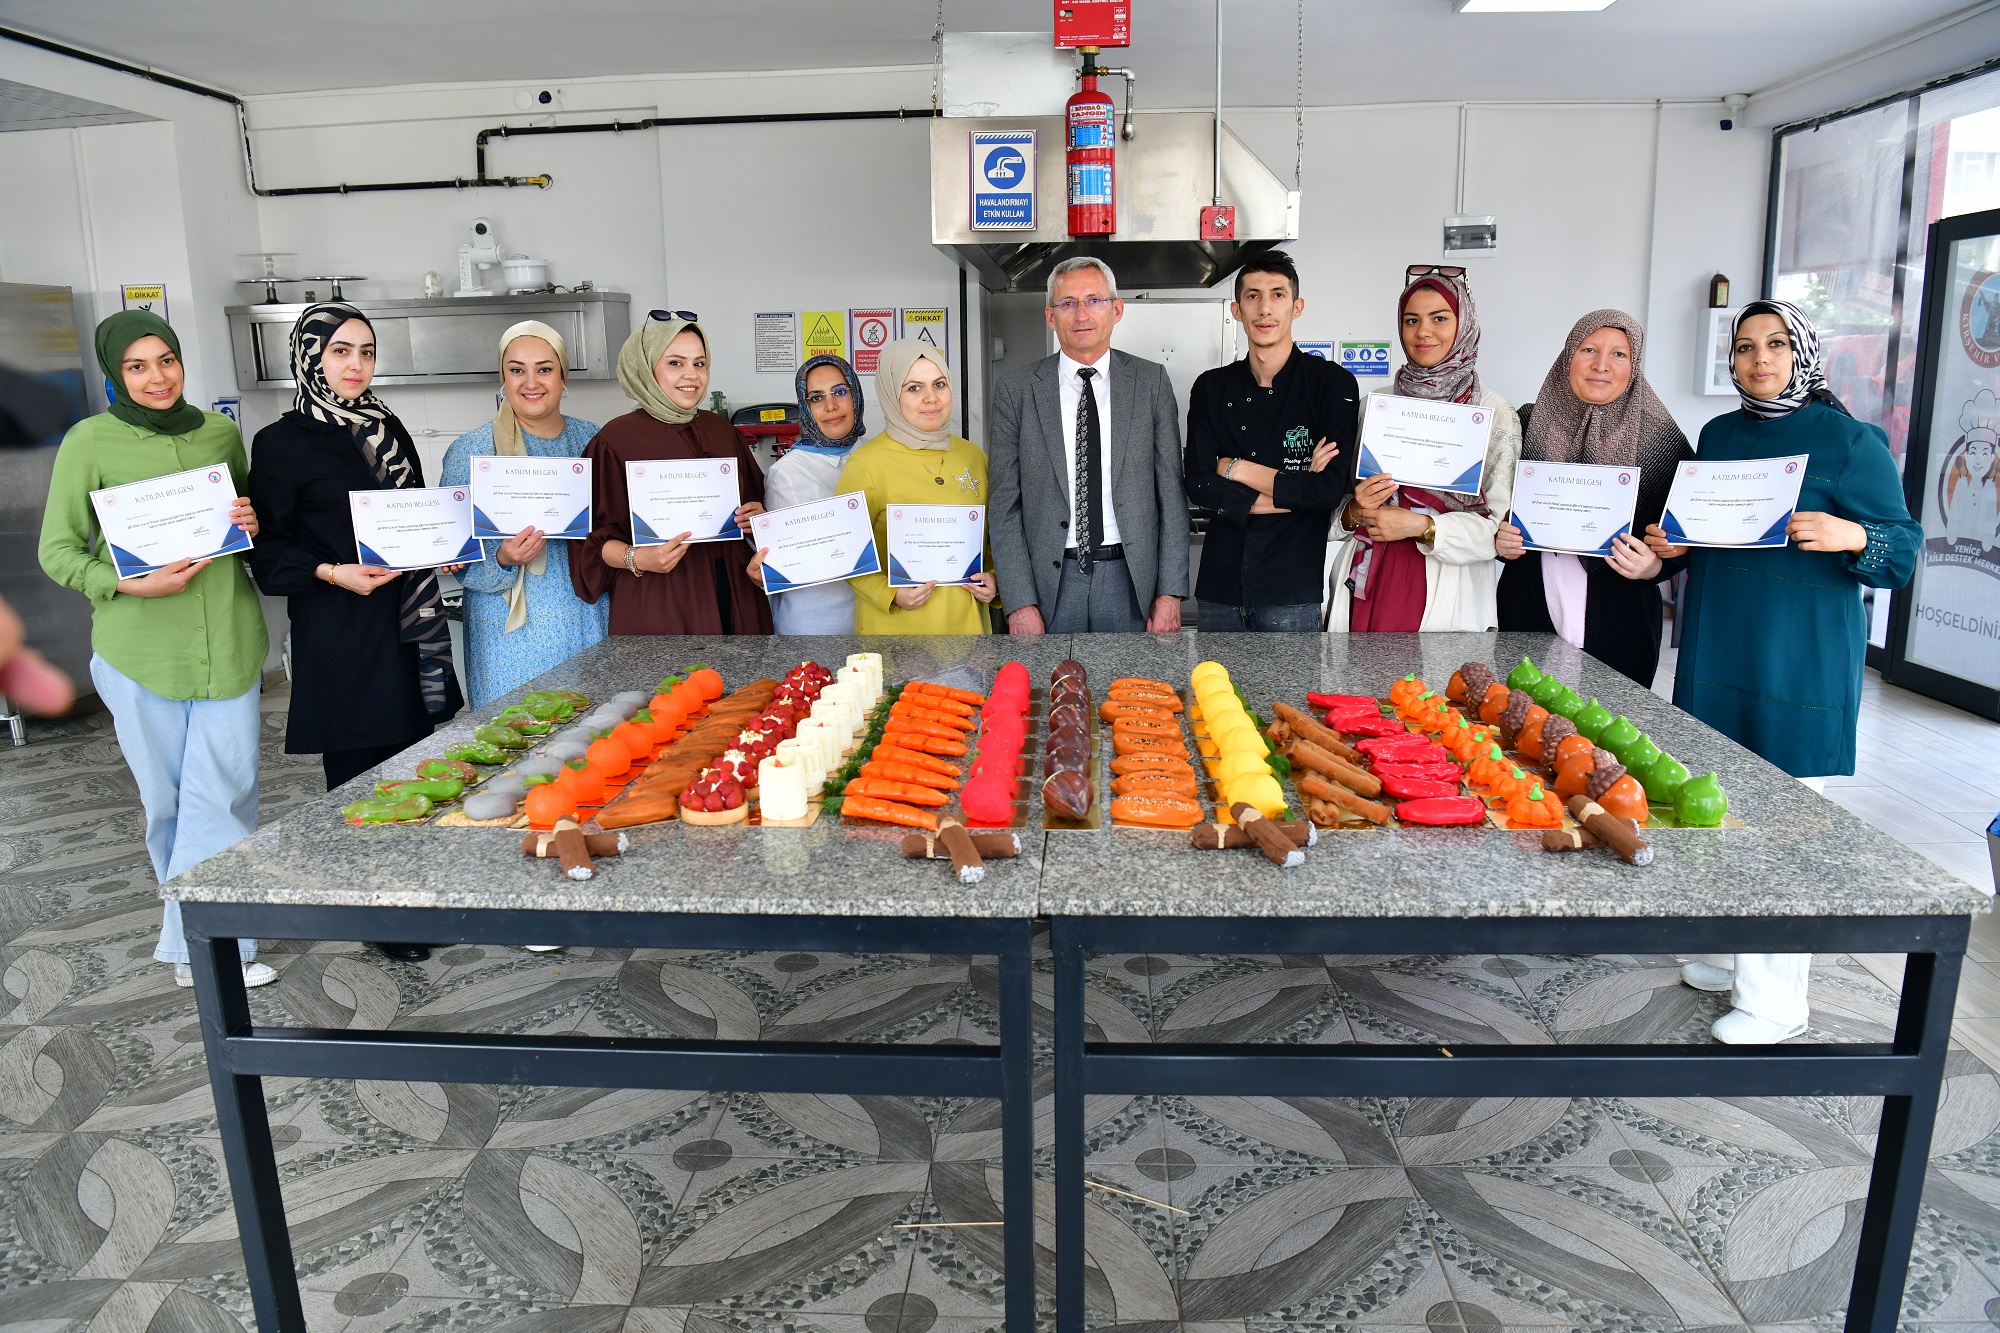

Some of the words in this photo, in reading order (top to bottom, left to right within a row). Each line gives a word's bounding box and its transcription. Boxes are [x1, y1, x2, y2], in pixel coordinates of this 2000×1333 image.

[980, 198, 1028, 206] HAVALANDIRMAYI
[984, 209, 1000, 218] ETKİN
[134, 290, 160, 298] DİKKAT
[1401, 410, 1428, 420] KATILIM
[1429, 414, 1456, 423] BELGESİ
[1283, 438, 1313, 448] KUKLA
[1741, 472, 1768, 480] BELGESİ
[1576, 477, 1602, 486] BELGESİ
[134, 492, 164, 503] KATILIM
[166, 484, 194, 497] BELGESİ
[414, 500, 440, 508] BELGESİ
[784, 517, 810, 526] KATILIM
[810, 510, 835, 522] BELGESİ
[1954, 544, 1981, 556] YENİCE
[1928, 552, 1944, 562] AİLE
[1945, 554, 1972, 564] DESTEK
[1974, 557, 2000, 574] MERKE
